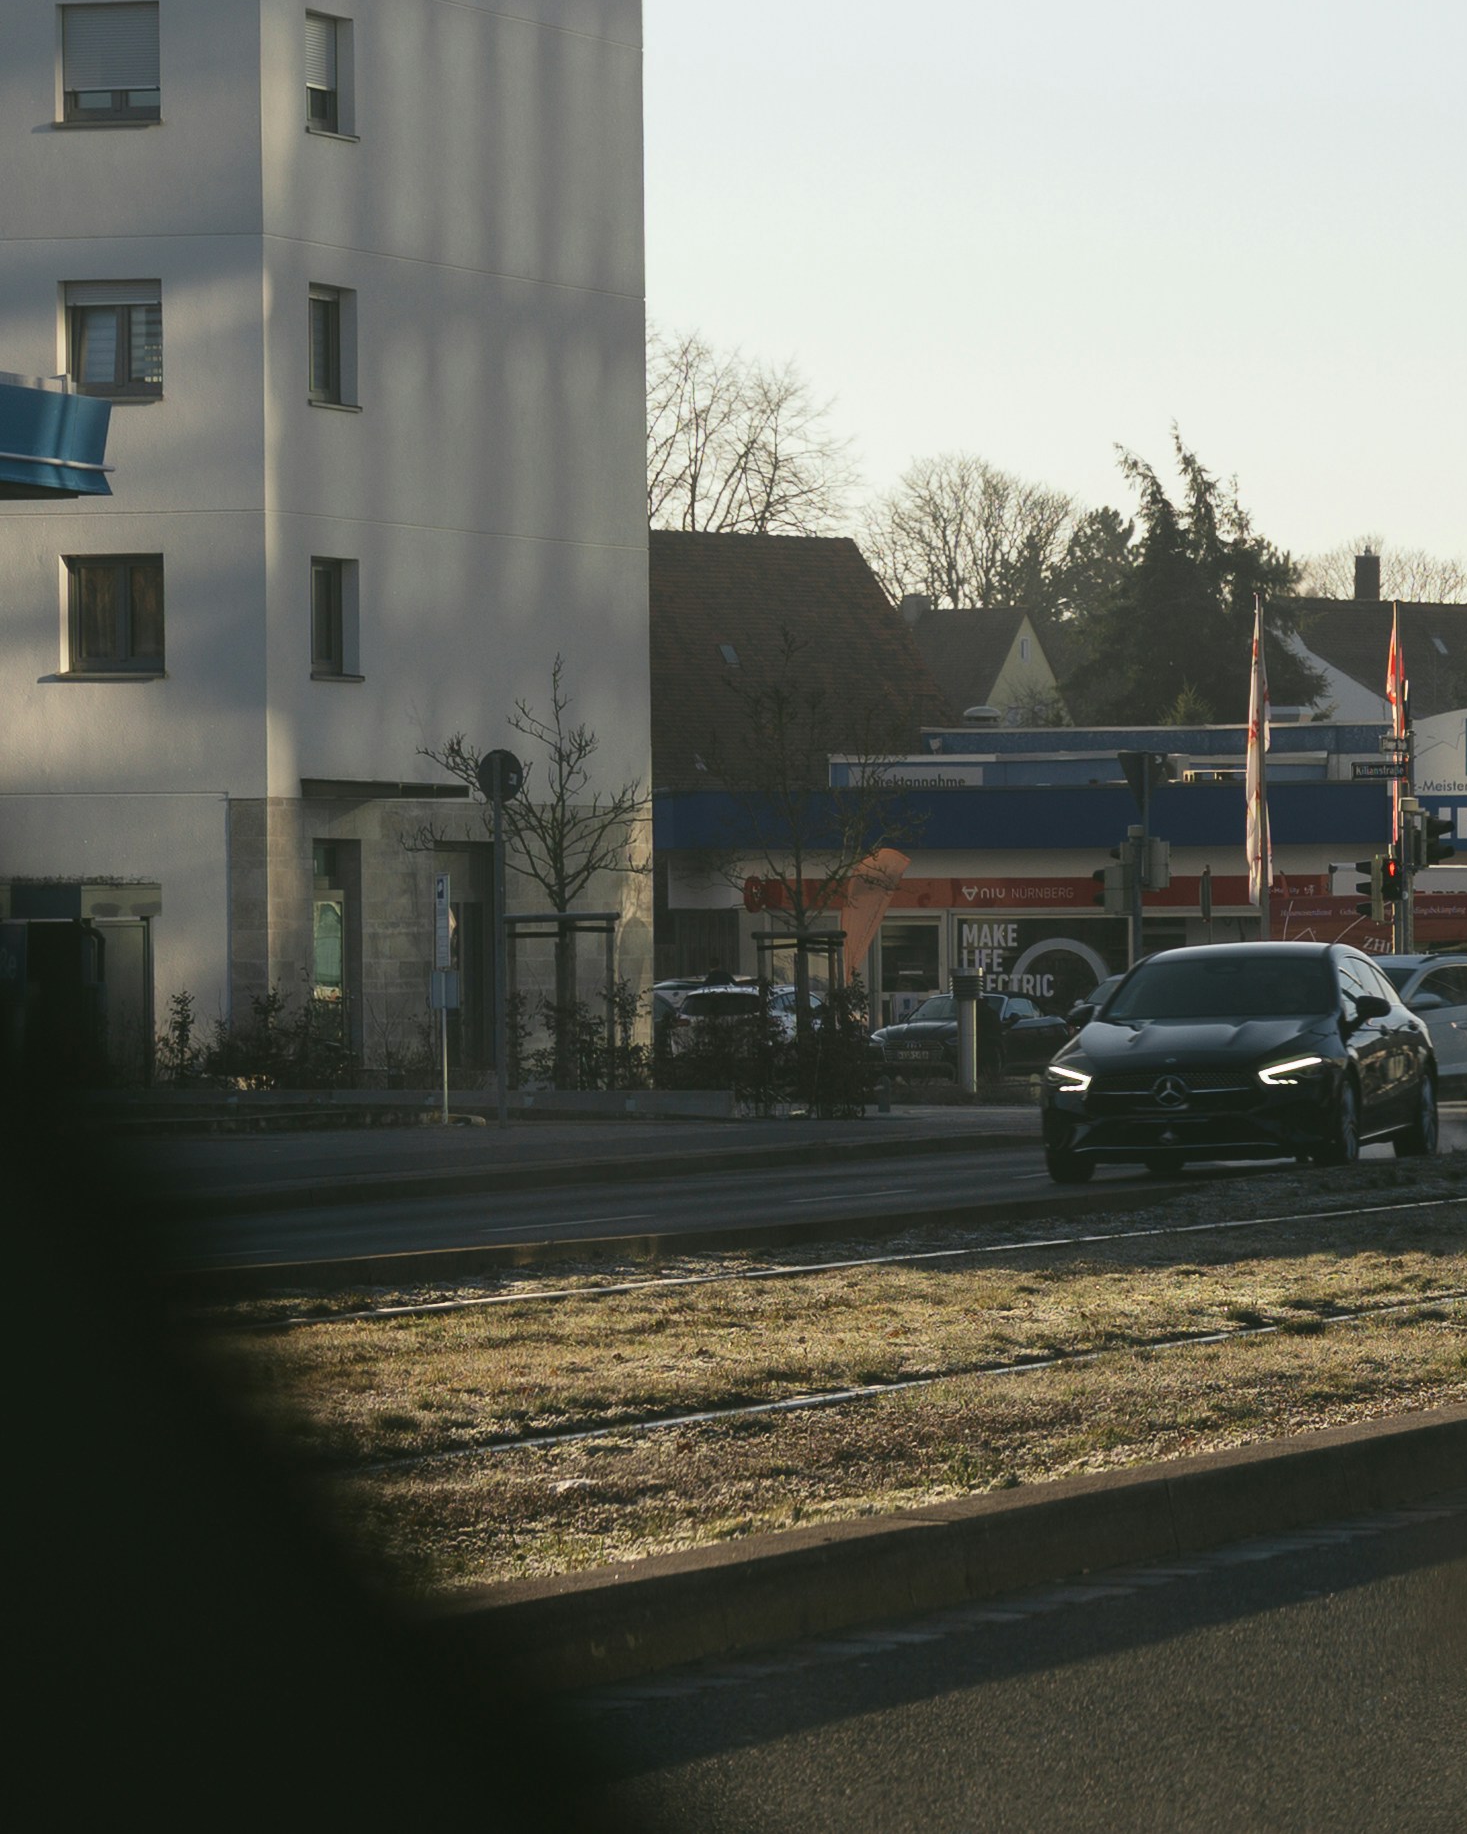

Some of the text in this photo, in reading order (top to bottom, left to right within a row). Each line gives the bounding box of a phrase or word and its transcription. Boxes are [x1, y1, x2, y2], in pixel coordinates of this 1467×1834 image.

[1011, 884, 1074, 899] NÜRNBERG
[962, 924, 1018, 947] MAKE
[962, 949, 1004, 972] LIFE
[986, 973, 1055, 998] ECTRIC
